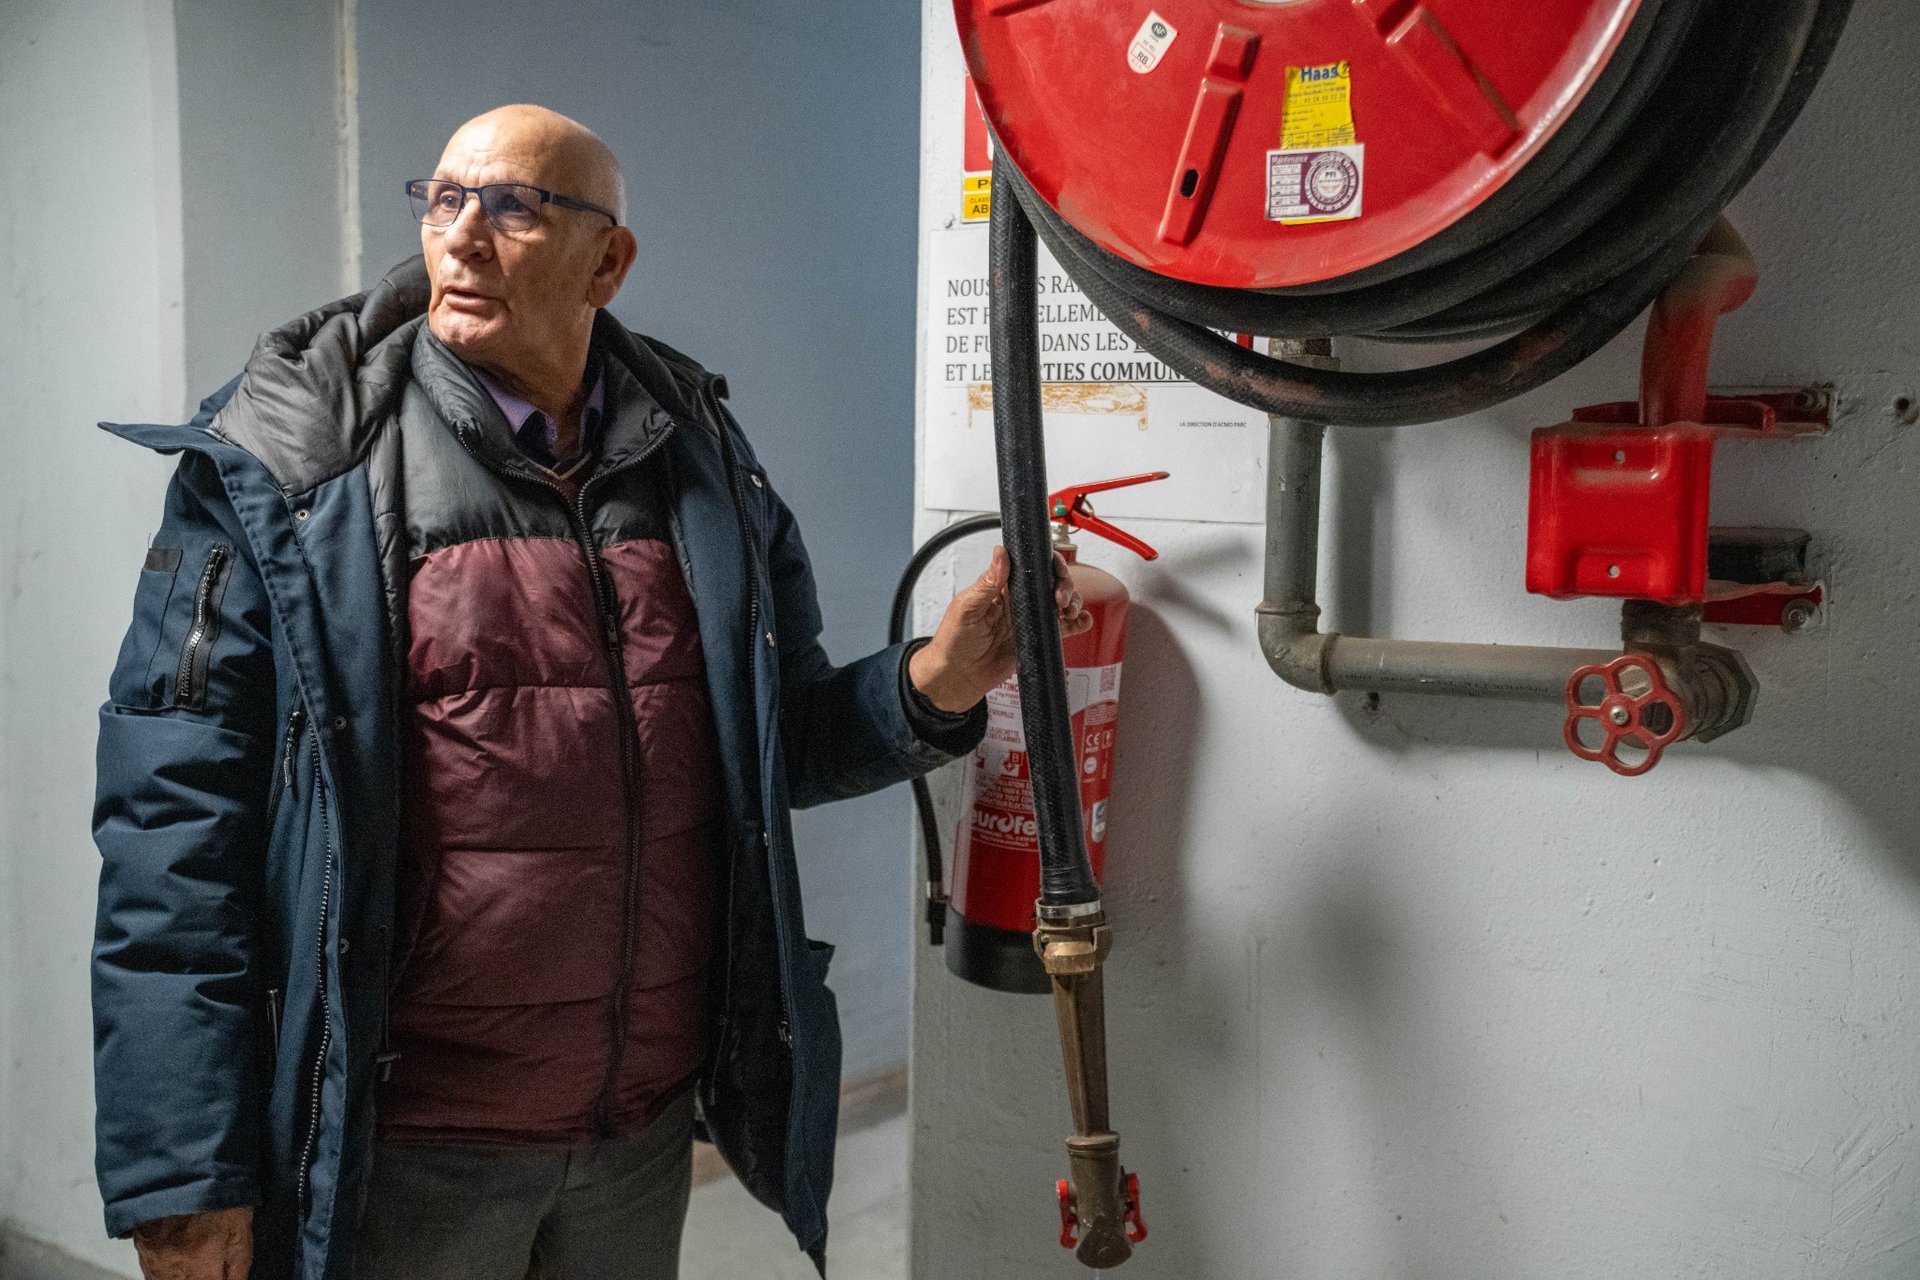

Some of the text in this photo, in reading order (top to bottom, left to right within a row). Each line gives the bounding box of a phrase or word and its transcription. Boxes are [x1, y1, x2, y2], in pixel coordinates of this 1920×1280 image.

[1136, 51, 1149, 65] RB
[1301, 65, 1339, 82] Haas
[977, 179, 992, 189] P
[972, 205, 990, 214] AB
[947, 307, 978, 325] EST
[946, 336, 969, 353] DE
[1042, 333, 1090, 352] DANS
[1096, 332, 1129, 351] LES
[945, 364, 967, 381] ET
[972, 363, 992, 381] LE
[972, 810, 1037, 836] eurofe
